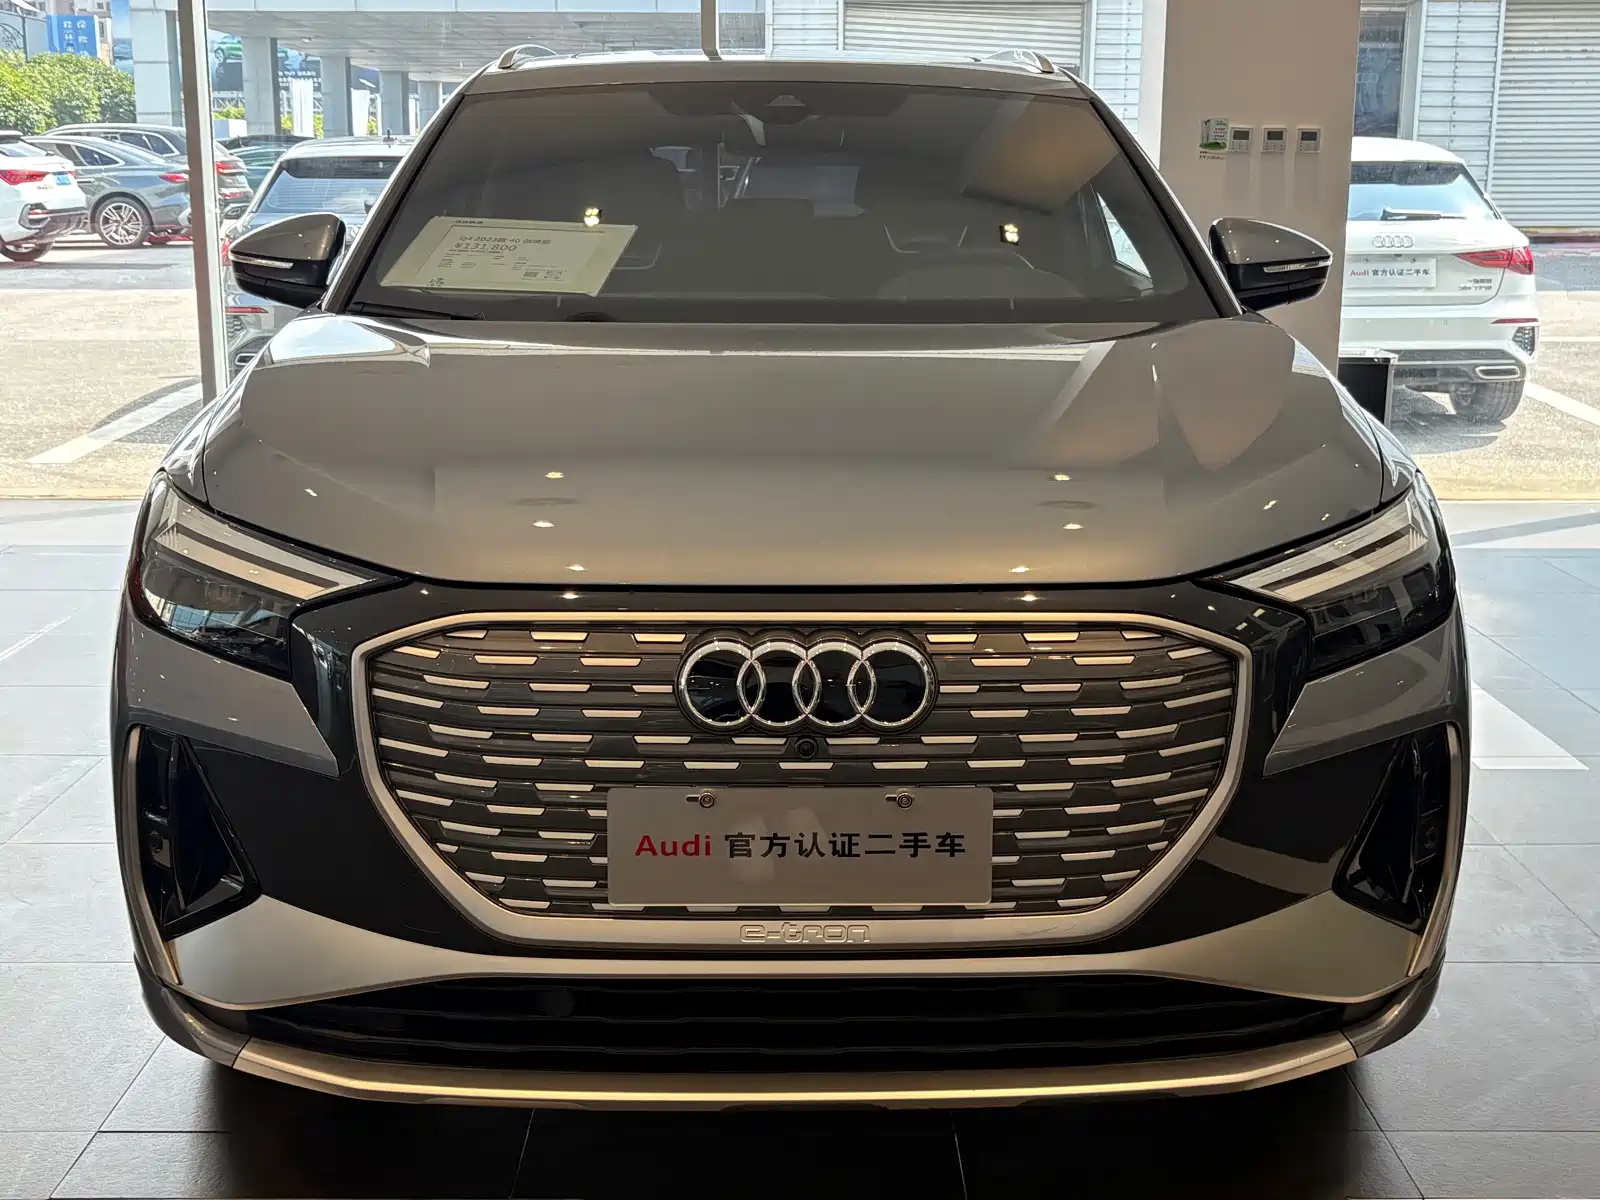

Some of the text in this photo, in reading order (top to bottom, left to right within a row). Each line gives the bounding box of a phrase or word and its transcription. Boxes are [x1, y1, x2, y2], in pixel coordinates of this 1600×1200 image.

[454, 242, 517, 252] ¥131,800
[1372, 268, 1430, 276] 官方认证二手车
[634, 832, 966, 858] Audi 官方认证二手车
[739, 921, 871, 943] e-tron
